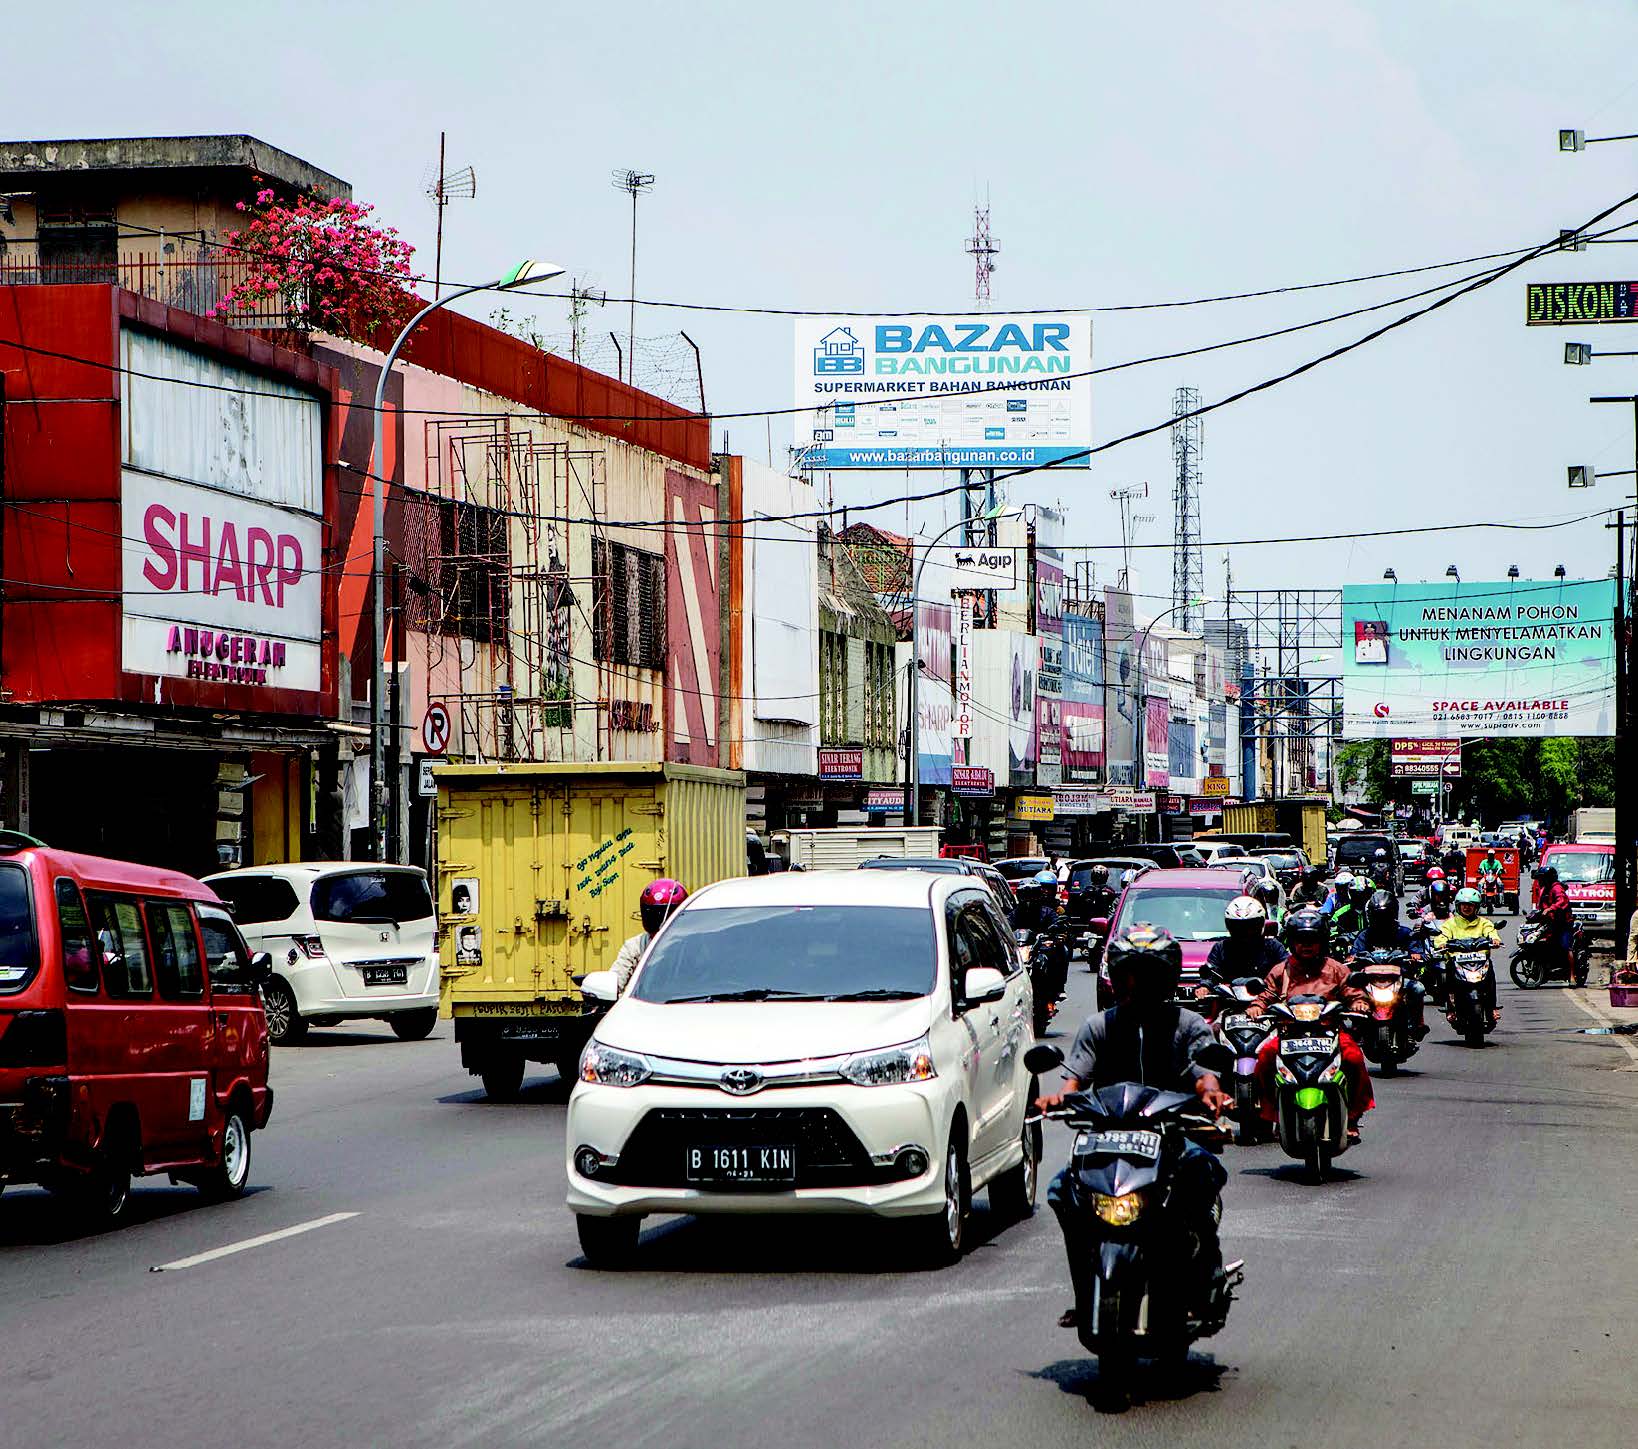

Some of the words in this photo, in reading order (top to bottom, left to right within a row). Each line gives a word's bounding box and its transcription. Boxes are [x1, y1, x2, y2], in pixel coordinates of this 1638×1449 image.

[1531, 285, 1614, 320] DISKON
[875, 323, 1070, 353] BAZAR
[875, 355, 1071, 375] BANGUNAN
[814, 382, 926, 393] SUPERMARKET
[930, 381, 981, 392] BAHAN
[986, 380, 1071, 391] BANGUNAN
[849, 449, 1035, 463] www.bazarbangunan.co.id
[143, 503, 303, 608] SHARP
[978, 553, 1012, 569] Agip
[1422, 607, 1511, 621] MENANAM
[1517, 606, 1578, 620] POHON
[1399, 627, 1450, 641] UNTUK
[1455, 625, 1602, 640] MENYELAMATKAN
[166, 624, 286, 667] ANUGERAH
[1444, 647, 1556, 661] LINGKUNGAN
[1433, 701, 1479, 711] SPACE
[1483, 700, 1569, 711] AVAILABLE
[692, 1149, 702, 1168] B
[714, 1149, 748, 1168] 1611
[761, 1149, 790, 1168] KIN
